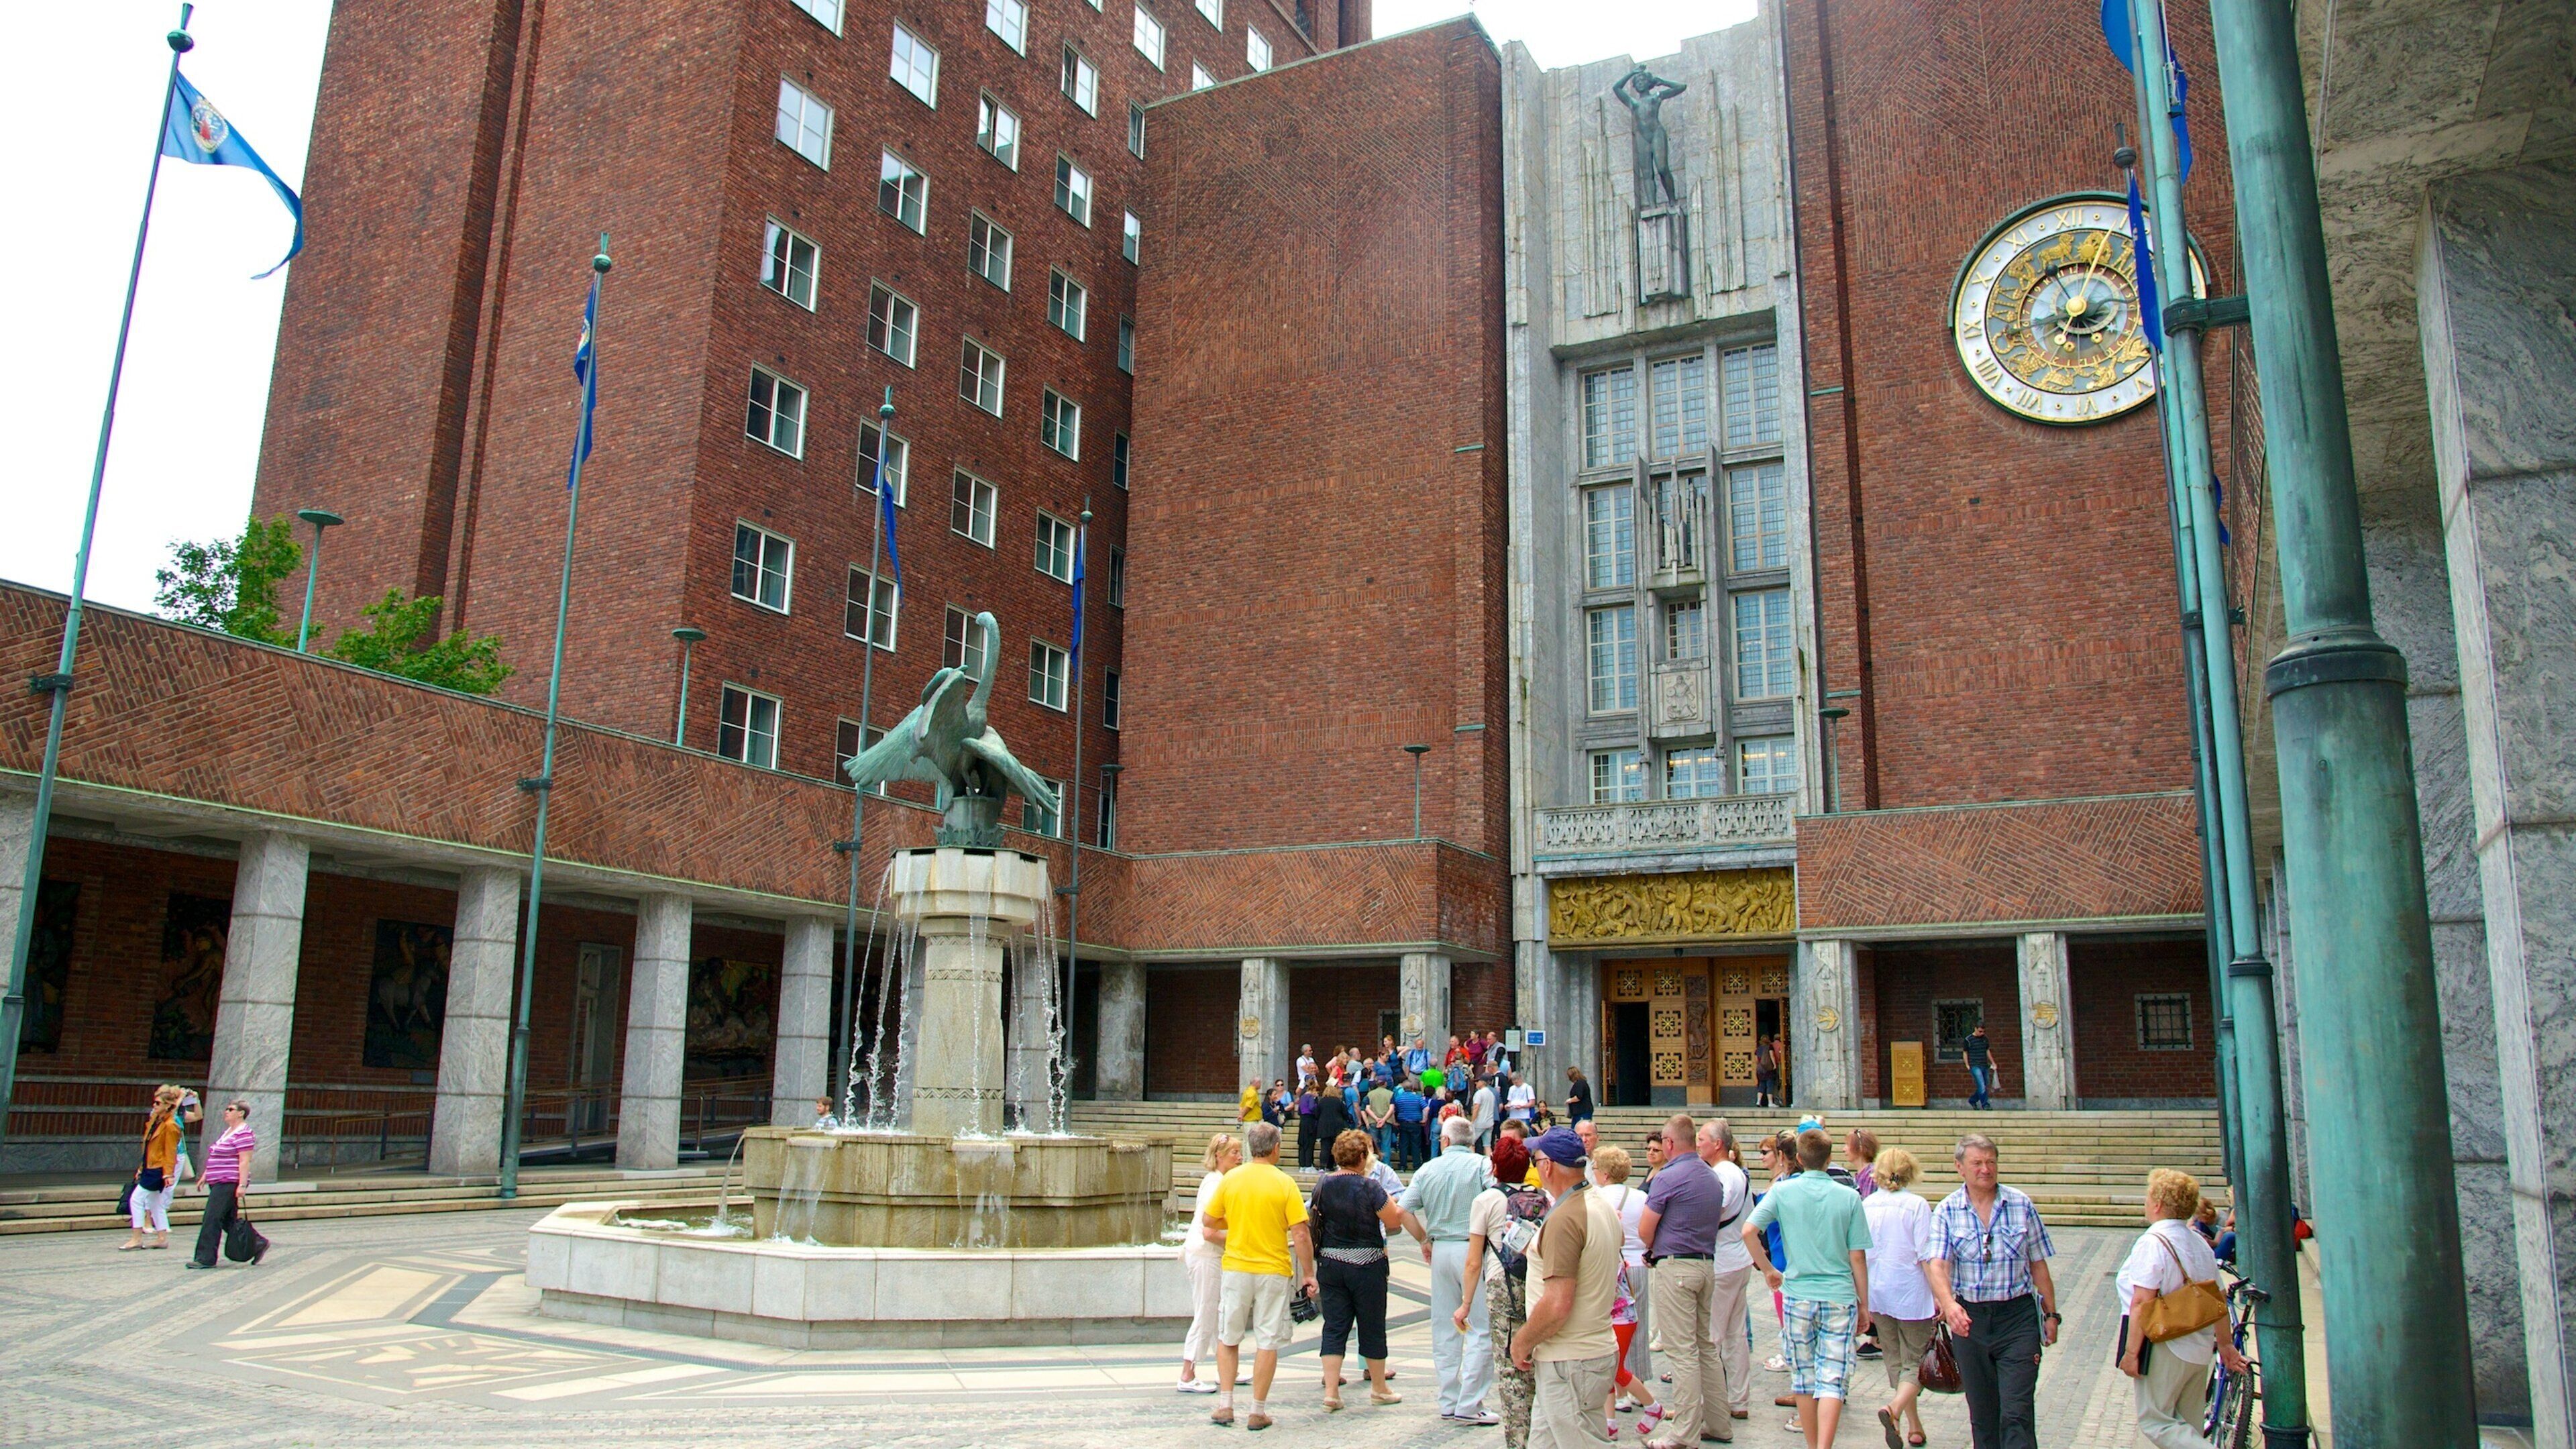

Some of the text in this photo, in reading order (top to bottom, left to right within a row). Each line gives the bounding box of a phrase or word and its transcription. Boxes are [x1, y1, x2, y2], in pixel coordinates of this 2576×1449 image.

[2055, 209, 2082, 230] XII
[2118, 212, 2129, 230] I
[2004, 228, 2030, 252] XI
[1972, 271, 1993, 289] X
[1964, 319, 1982, 339] IX
[1976, 358, 2003, 388] VIII
[2135, 376, 2153, 395] V
[2016, 389, 2041, 412] VII
[2076, 396, 2098, 414] VI
